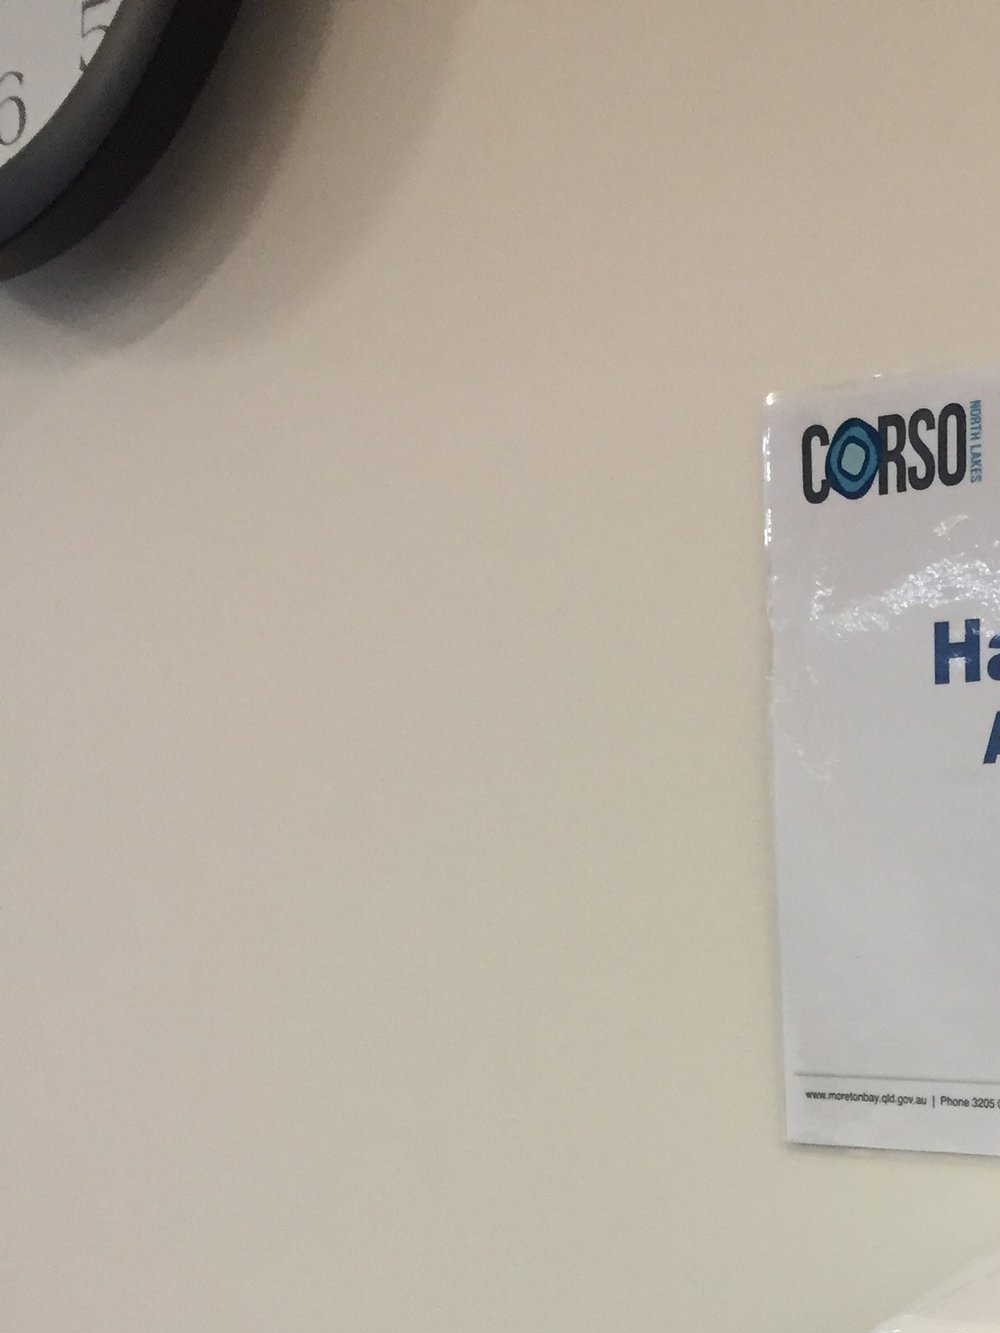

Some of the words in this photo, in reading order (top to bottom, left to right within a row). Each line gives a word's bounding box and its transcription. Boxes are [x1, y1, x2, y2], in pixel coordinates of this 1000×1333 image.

[970, 400, 982, 440] NORTH
[802, 402, 967, 504] CORSO
[970, 444, 982, 483] LAKES
[805, 1090, 927, 1107] www.moretonbay.qld.gov.au
[940, 1095, 970, 1108] Phone
[972, 1097, 995, 1110] 3205
